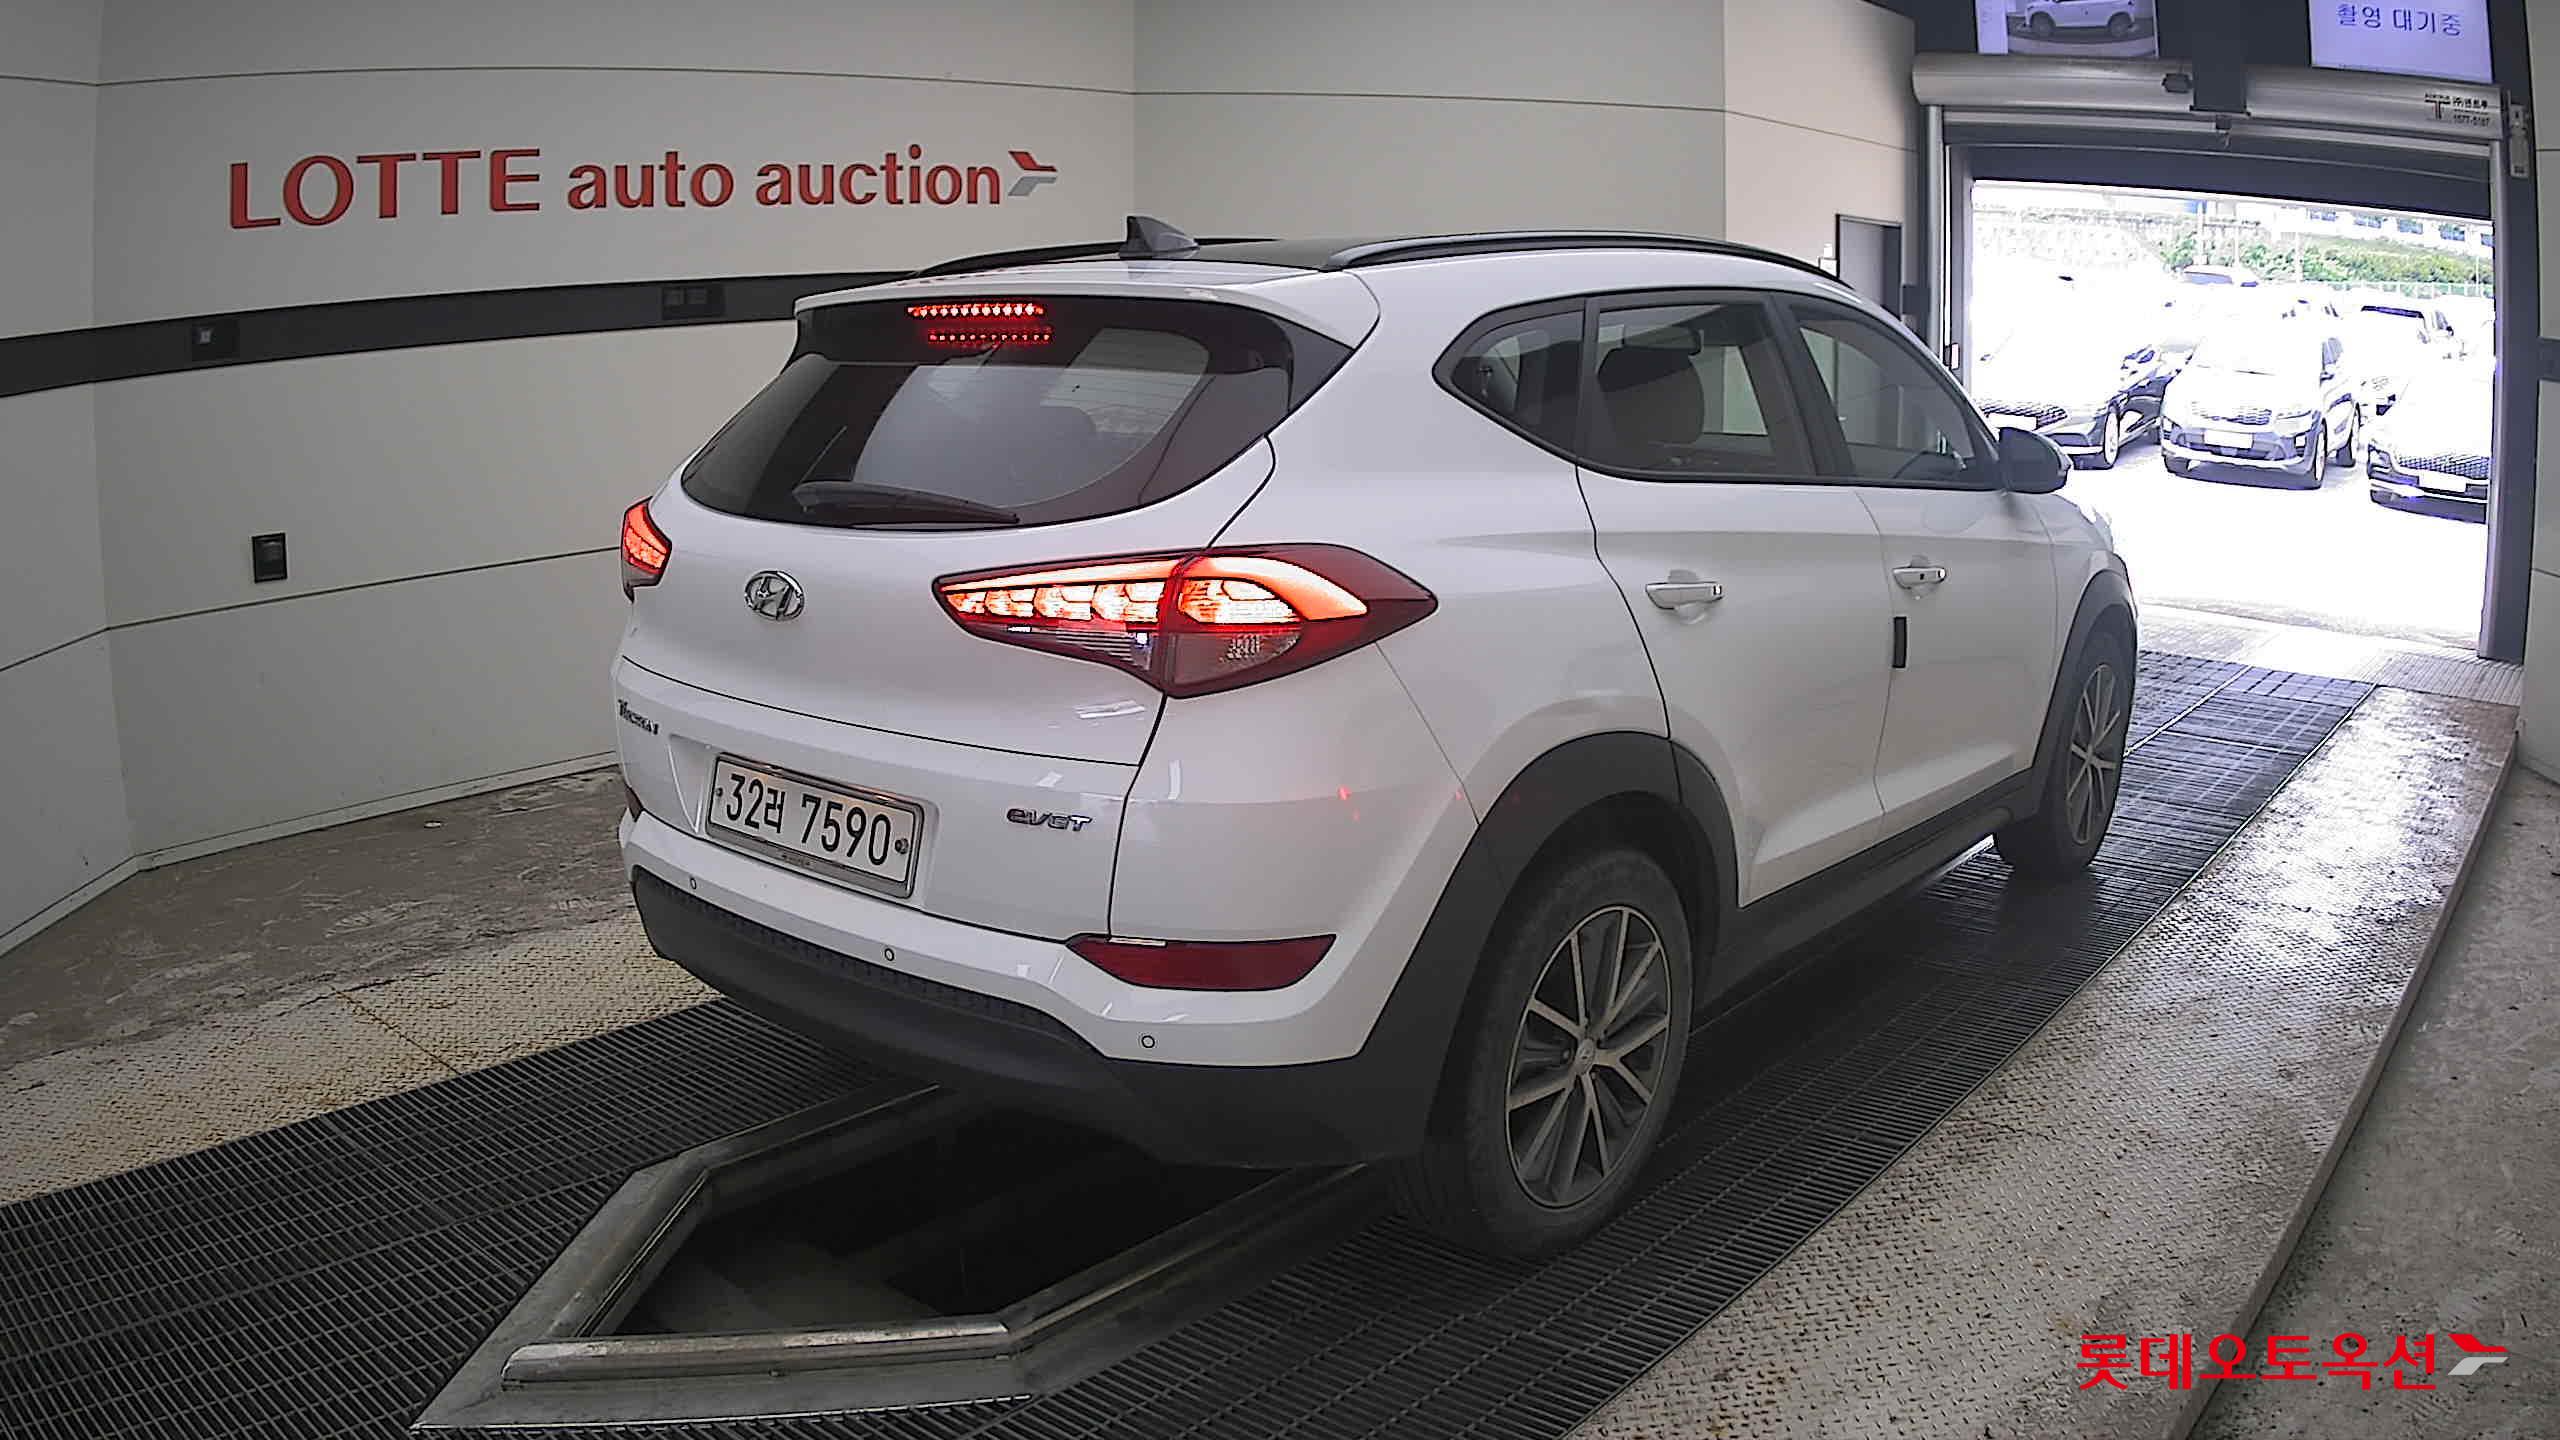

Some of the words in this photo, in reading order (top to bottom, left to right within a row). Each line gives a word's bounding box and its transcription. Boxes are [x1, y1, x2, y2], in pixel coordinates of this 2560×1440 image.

[2337, 3, 2382, 29] 촬영
[2392, 9, 2462, 37] 대기중
[230, 148, 541, 229] LOTTE
[567, 150, 734, 210] auto
[755, 143, 1001, 206] auction
[726, 773, 786, 834] 32러
[800, 793, 891, 866] 7590
